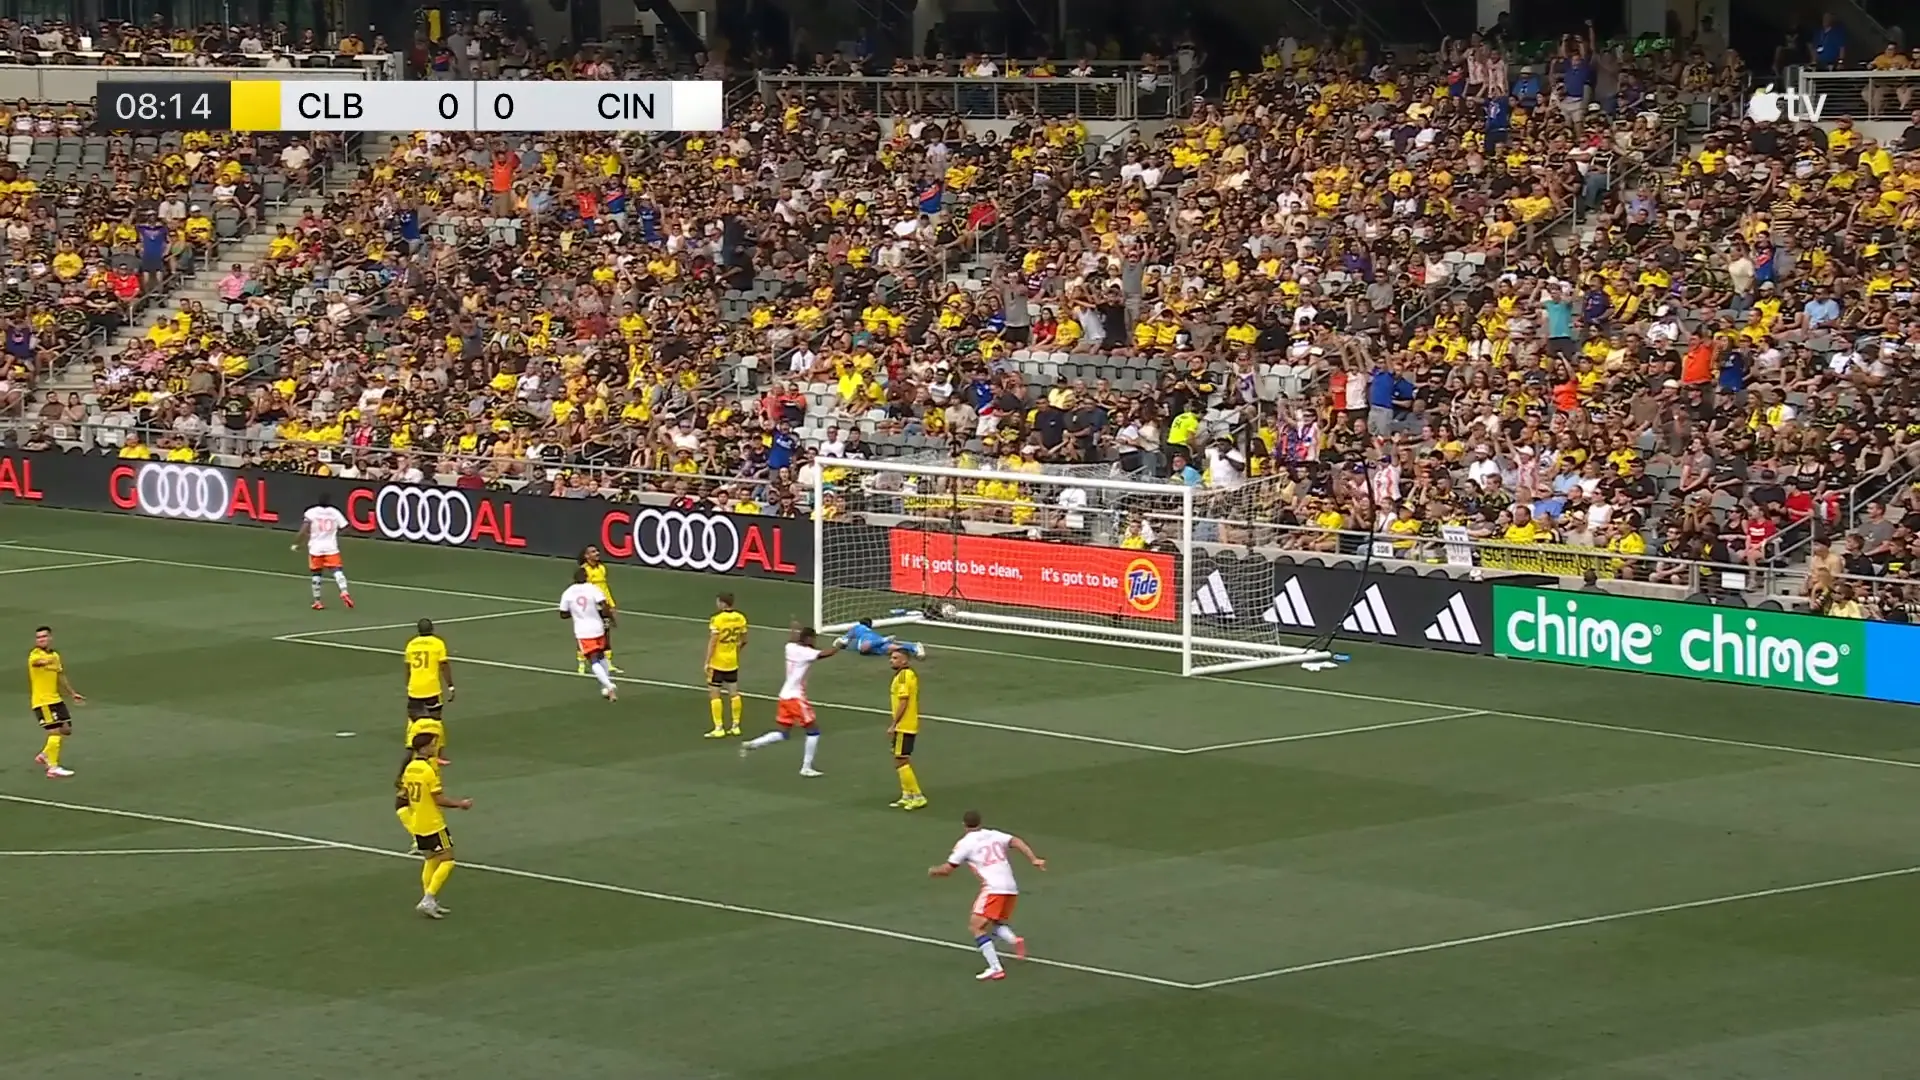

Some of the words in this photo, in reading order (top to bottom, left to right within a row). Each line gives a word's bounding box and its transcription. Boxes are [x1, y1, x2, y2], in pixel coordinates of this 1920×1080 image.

[901, 553, 911, 568] If
[932, 556, 953, 573] got
[955, 559, 968, 573] to
[970, 560, 986, 574] be
[988, 562, 1024, 581] clean,
[1041, 566, 1060, 583] it's
[1062, 571, 1083, 587] got
[1085, 573, 1100, 587] to
[1102, 573, 1119, 588] be
[1128, 569, 1159, 601] Tide
[576, 596, 588, 612] 9
[719, 627, 739, 644] 25
[411, 650, 430, 669] 31
[978, 841, 1007, 867] 20
